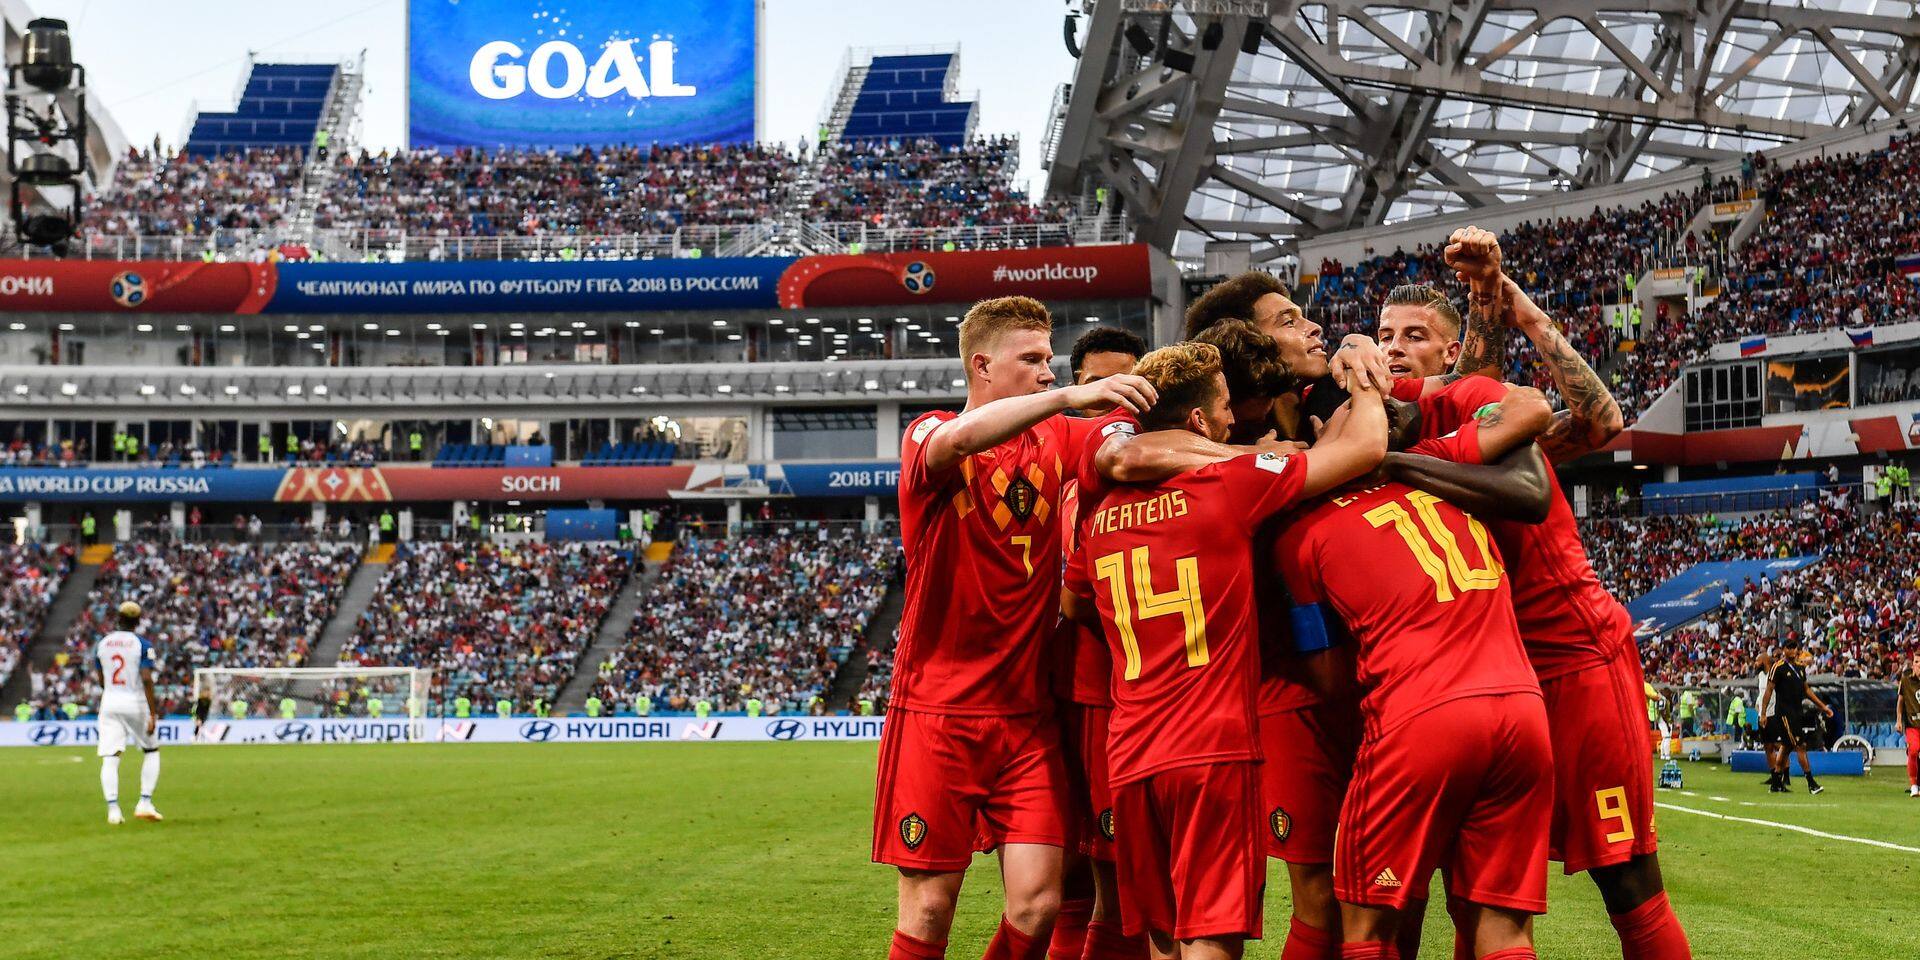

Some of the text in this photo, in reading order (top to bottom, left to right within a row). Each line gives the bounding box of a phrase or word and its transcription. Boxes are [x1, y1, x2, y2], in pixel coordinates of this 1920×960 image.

[469, 40, 697, 99] GOAL
[993, 263, 1098, 283] #worldcup
[0, 275, 53, 295] ОЧИ
[297, 276, 759, 295] ЧЕМПИОНАТ МИРА ПО ФУТБОЛУ FIFA 2018 В РОССИИ
[0, 476, 209, 493] A WORLD CUP RUSSIA
[501, 476, 560, 492] SOCHI
[829, 470, 900, 487] 2018 FIF
[1091, 490, 1188, 537] MERTENS
[1362, 490, 1505, 603] 10
[1011, 535, 1034, 582] 7
[1095, 545, 1210, 681] 14
[112, 654, 126, 685] 2
[567, 723, 670, 738] HYUNDAI
[1596, 786, 1635, 843] 9
[1375, 879, 1402, 887] adidas
